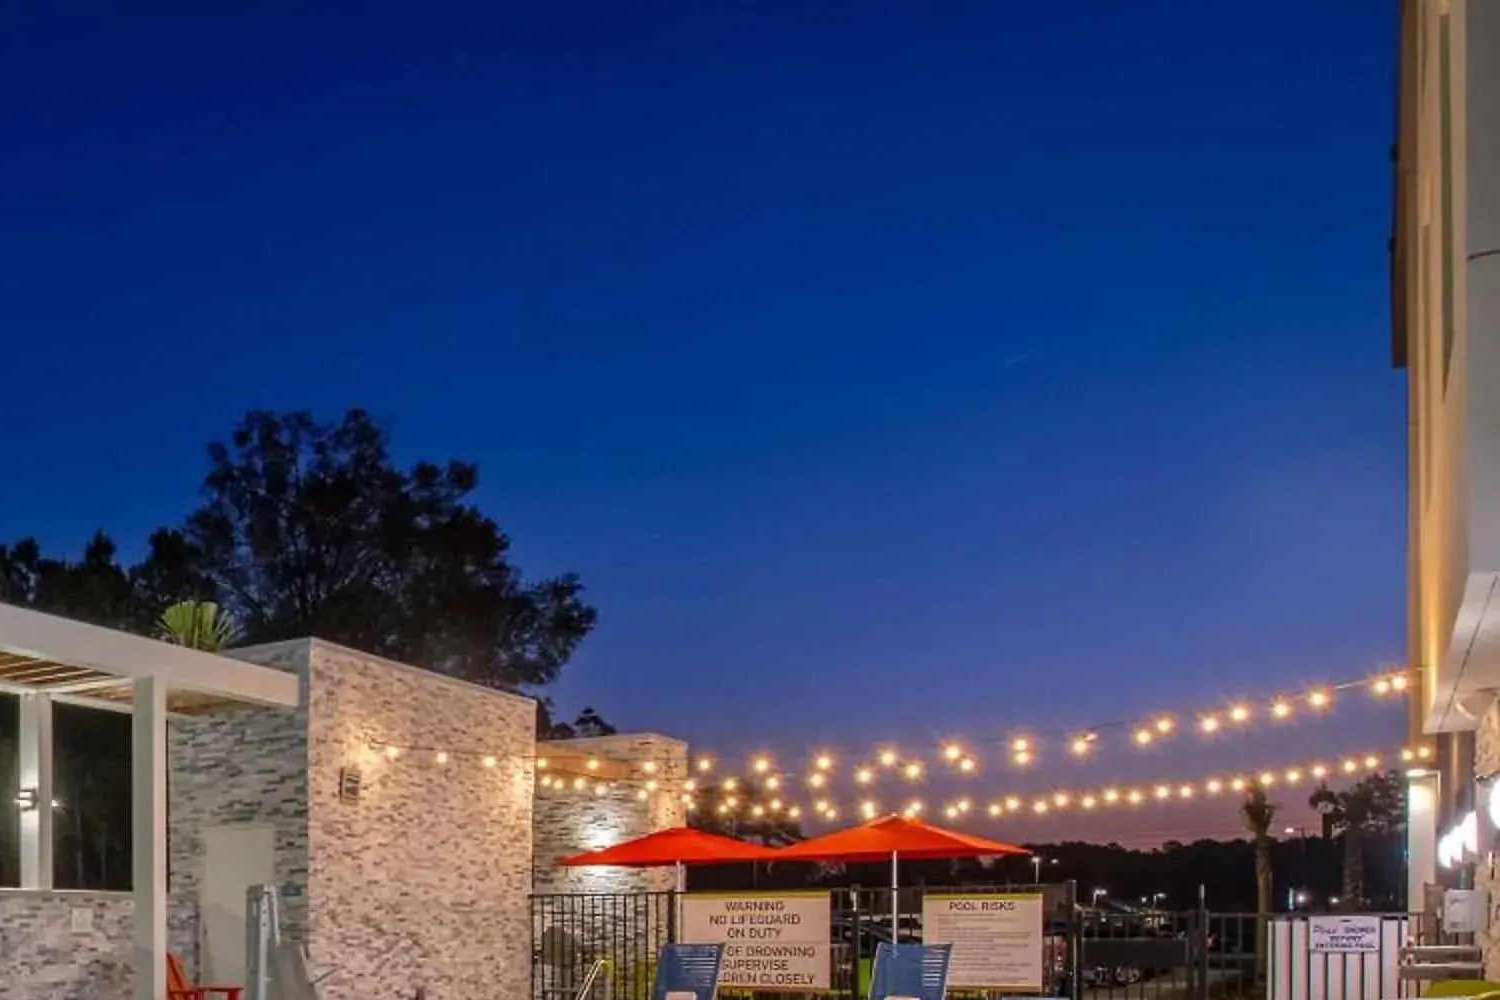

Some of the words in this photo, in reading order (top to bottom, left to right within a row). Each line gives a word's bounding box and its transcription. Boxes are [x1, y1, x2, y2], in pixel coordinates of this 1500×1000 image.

[725, 901, 785, 912] WARNING
[949, 901, 978, 911] POOL
[709, 915, 728, 925] NO
[731, 914, 801, 925] LIFEGUARD
[727, 928, 745, 939] ON
[749, 928, 782, 939] DUTY
[727, 946, 743, 957] OF
[746, 946, 816, 957] DROWNING
[722, 959, 789, 971] SUPERVISE
[759, 973, 816, 985] CLOSELY
